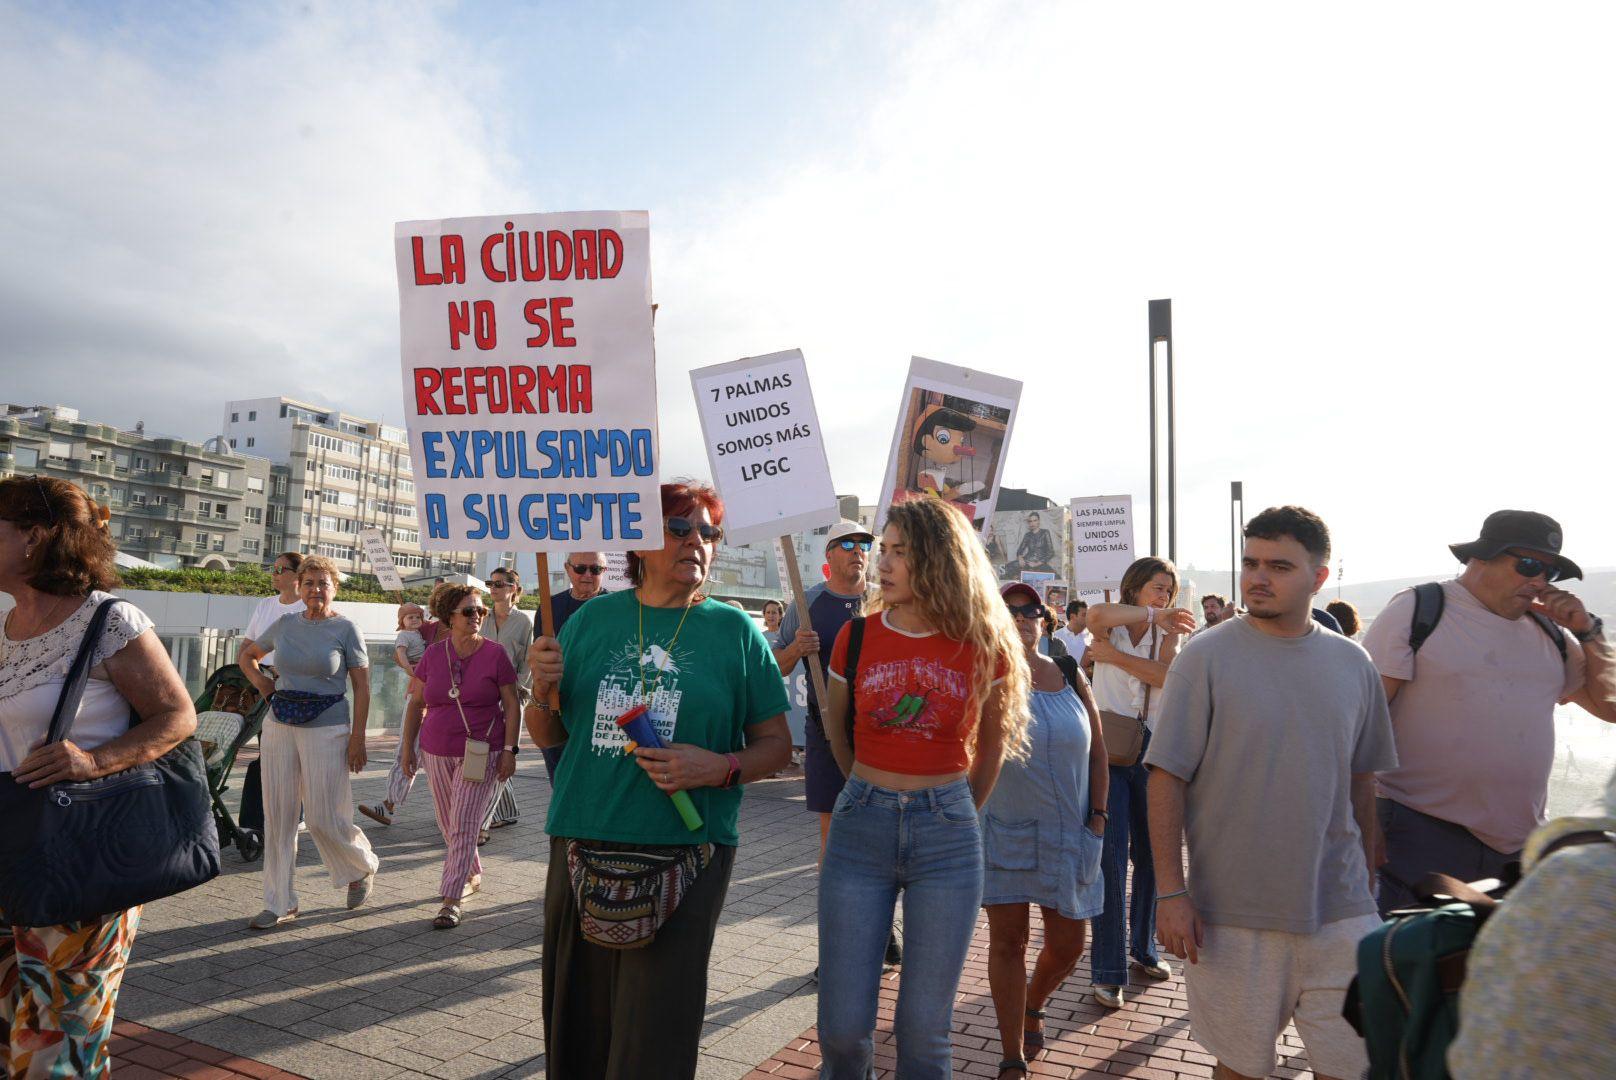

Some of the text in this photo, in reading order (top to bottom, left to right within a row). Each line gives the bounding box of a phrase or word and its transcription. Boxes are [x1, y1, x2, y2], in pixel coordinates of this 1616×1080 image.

[412, 234, 465, 285] LA
[448, 297, 576, 350] NO SE
[414, 364, 593, 415] REFORMA
[711, 373, 793, 402] 7 PALMAS
[725, 401, 791, 427] UNIDOS
[717, 423, 811, 456] SOMOS MÁS
[421, 428, 654, 479] EXPULSANDO
[741, 456, 791, 481] LPGC
[425, 492, 643, 541] A SU GENTE
[1076, 507, 1125, 517] LAS PALMAS
[1077, 543, 1128, 553] SOMOS MÁS
[1084, 530, 1120, 539] UNIDOS
[595, 732, 608, 740] DE
[596, 722, 613, 731] EN
